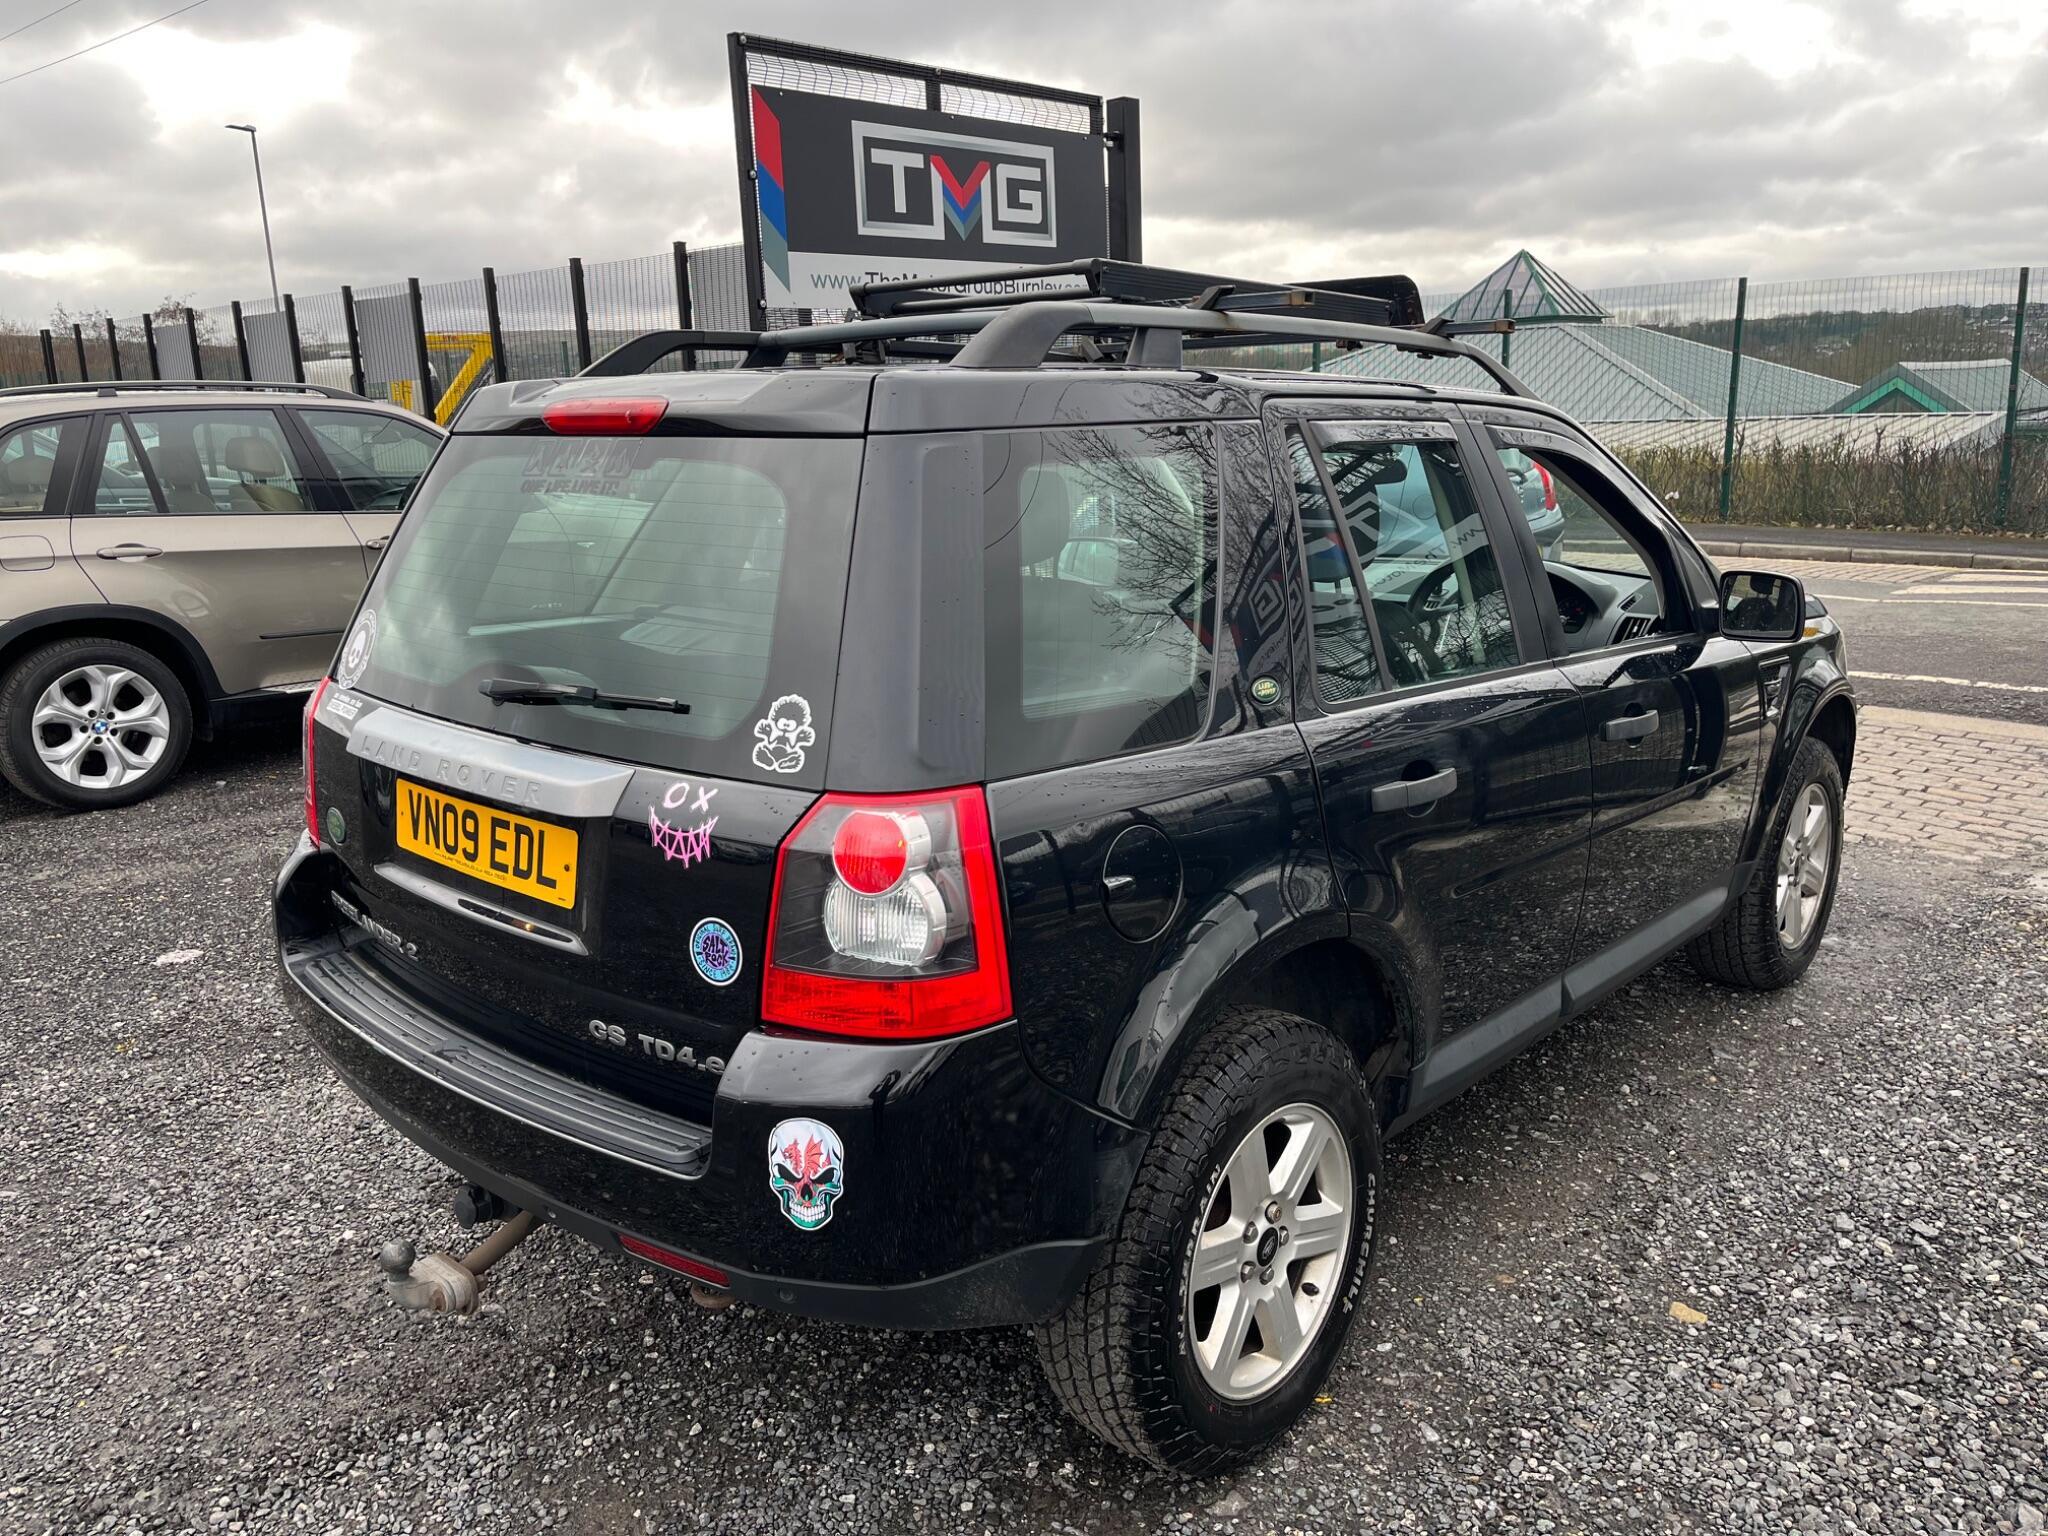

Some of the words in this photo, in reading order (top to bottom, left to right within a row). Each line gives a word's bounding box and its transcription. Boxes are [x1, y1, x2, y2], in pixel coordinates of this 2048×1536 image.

[870, 147, 1043, 240] TMG
[359, 735, 422, 772] LAND
[436, 759, 542, 806] ROVER
[408, 788, 480, 863] VN09
[490, 815, 557, 890] EDL
[406, 942, 419, 961] 2
[702, 935, 728, 954] SALT
[704, 950, 729, 968] ROCK
[589, 1020, 627, 1047] GS
